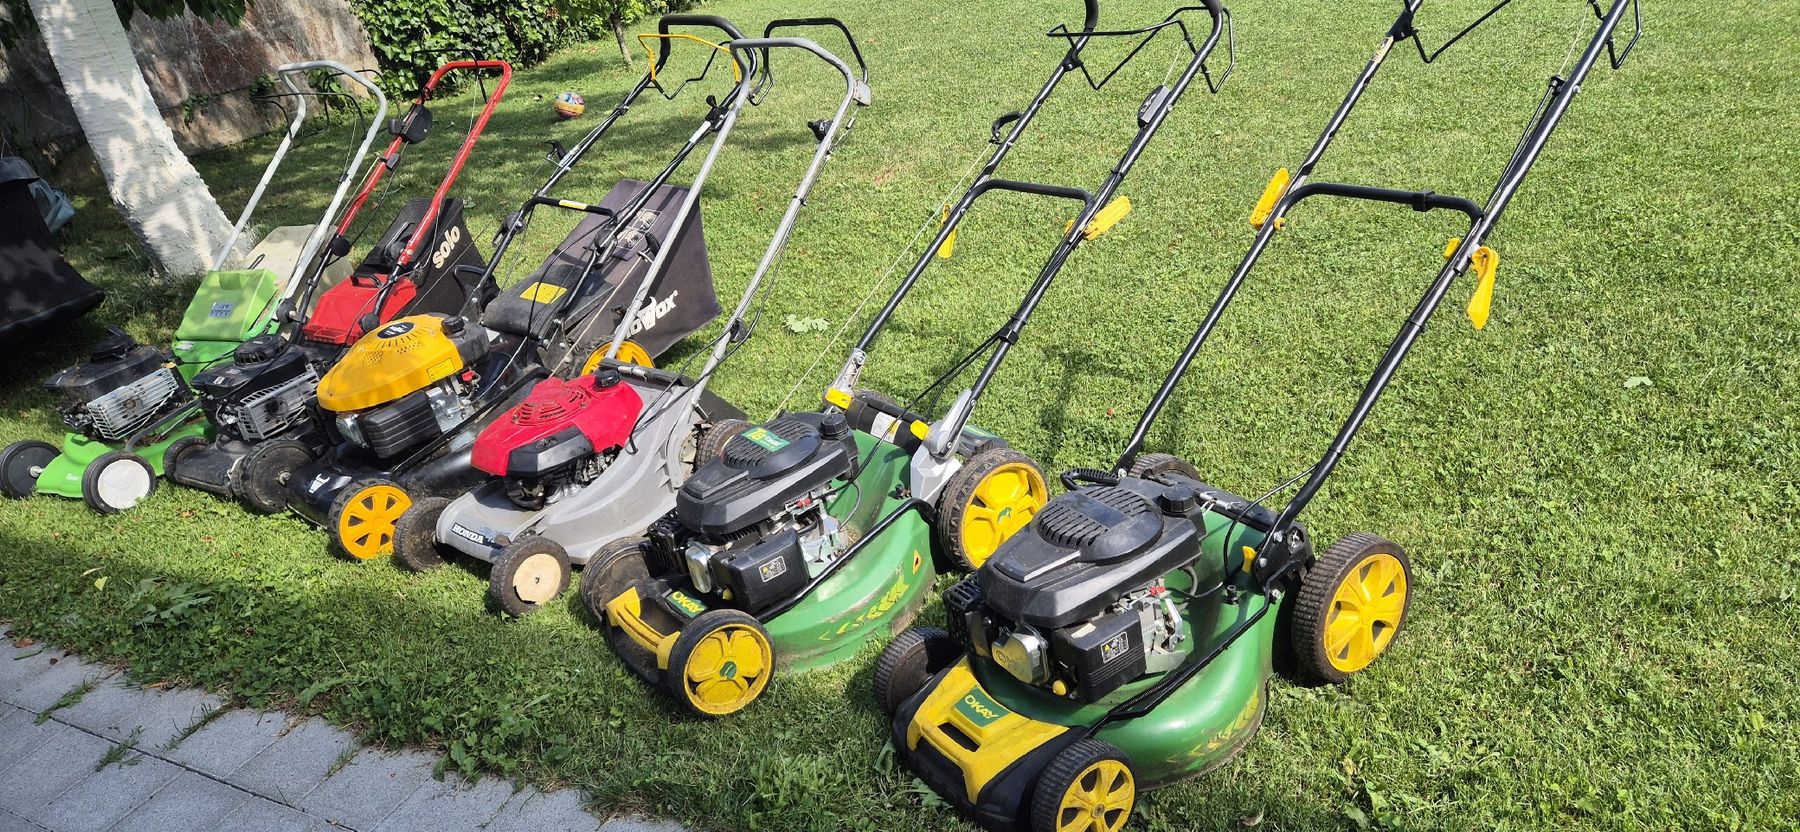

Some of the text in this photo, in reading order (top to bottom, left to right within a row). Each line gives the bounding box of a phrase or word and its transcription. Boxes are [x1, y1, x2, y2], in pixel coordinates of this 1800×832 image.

[433, 226, 460, 269] solo
[452, 523, 484, 544] HONDA
[672, 591, 705, 613] OKAY
[965, 694, 999, 719] OKAY
